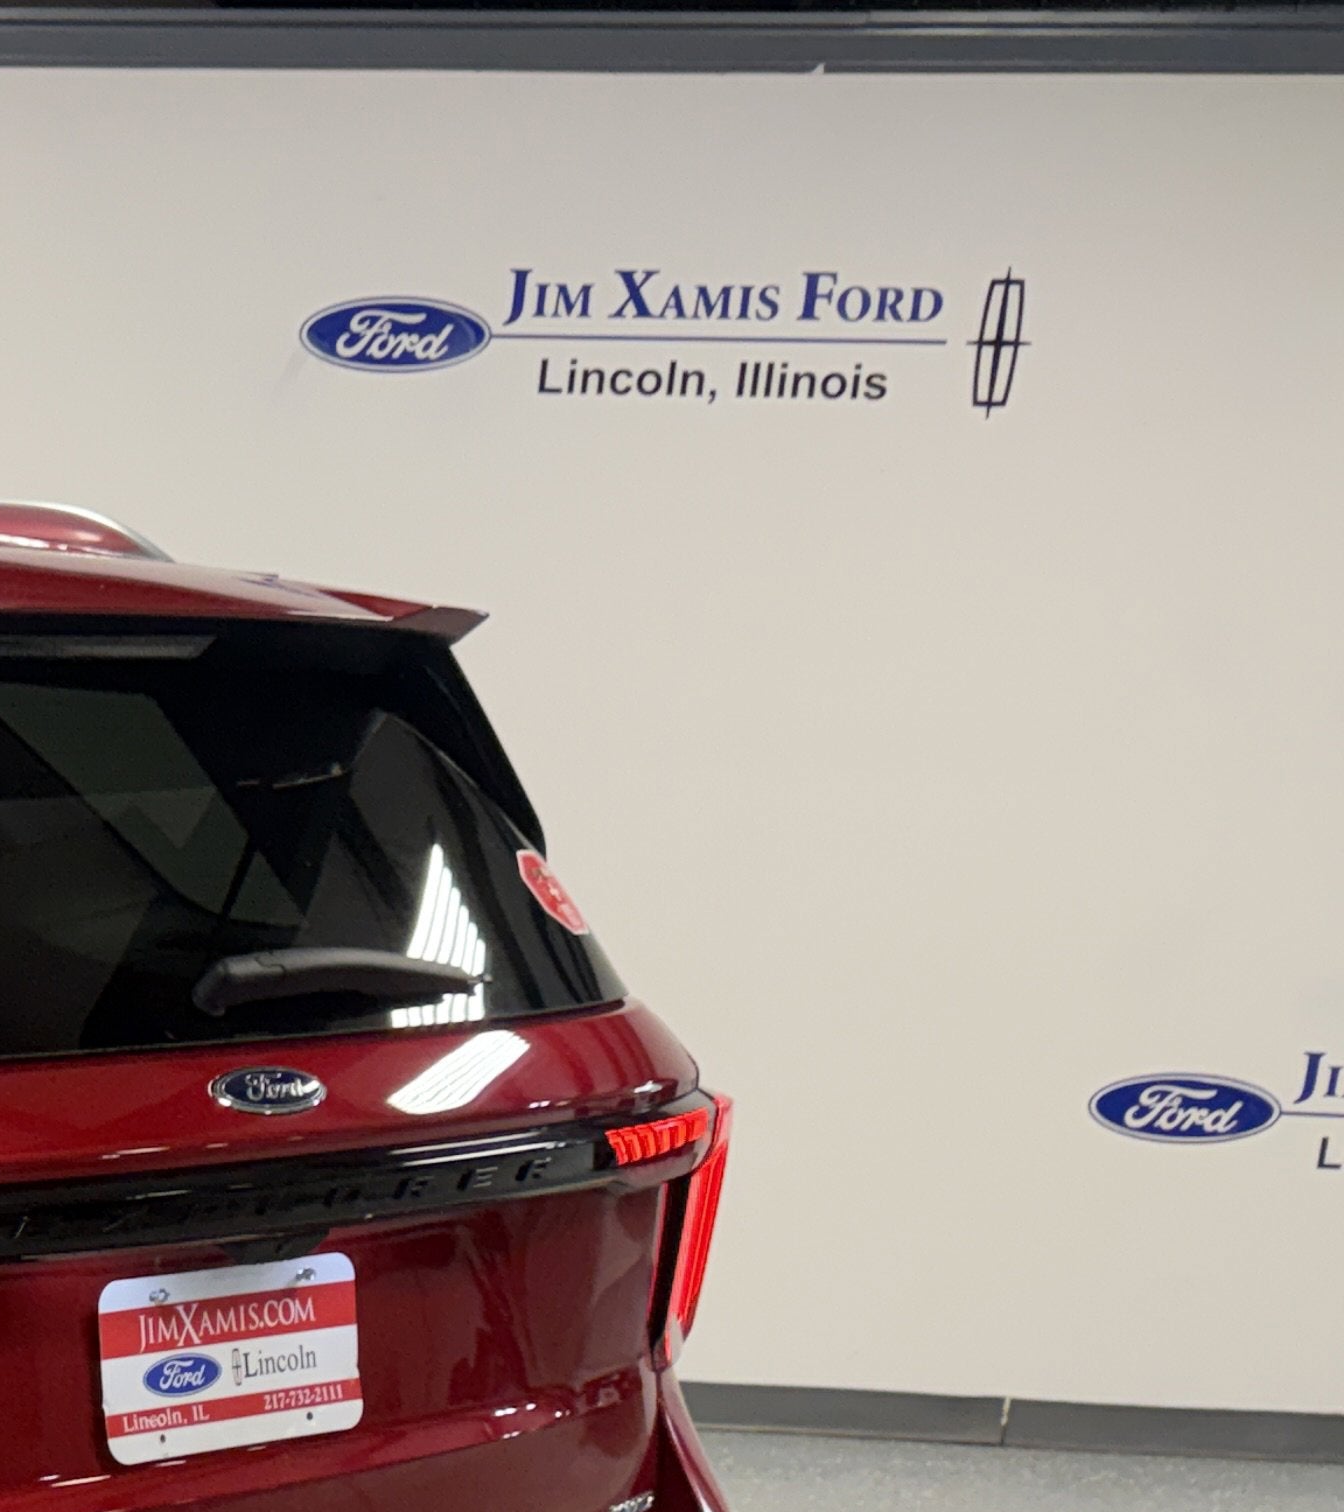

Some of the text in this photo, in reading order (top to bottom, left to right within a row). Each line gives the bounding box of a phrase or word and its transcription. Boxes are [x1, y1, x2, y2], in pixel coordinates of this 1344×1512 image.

[503, 268, 945, 326] JIM XAMIS FORD
[336, 307, 450, 362] Ford
[537, 358, 888, 404] Lincoln, Illinois
[1124, 1084, 1244, 1133] Ford
[243, 1345, 317, 1379] Lincoln
[193, 1404, 210, 1421] IL
